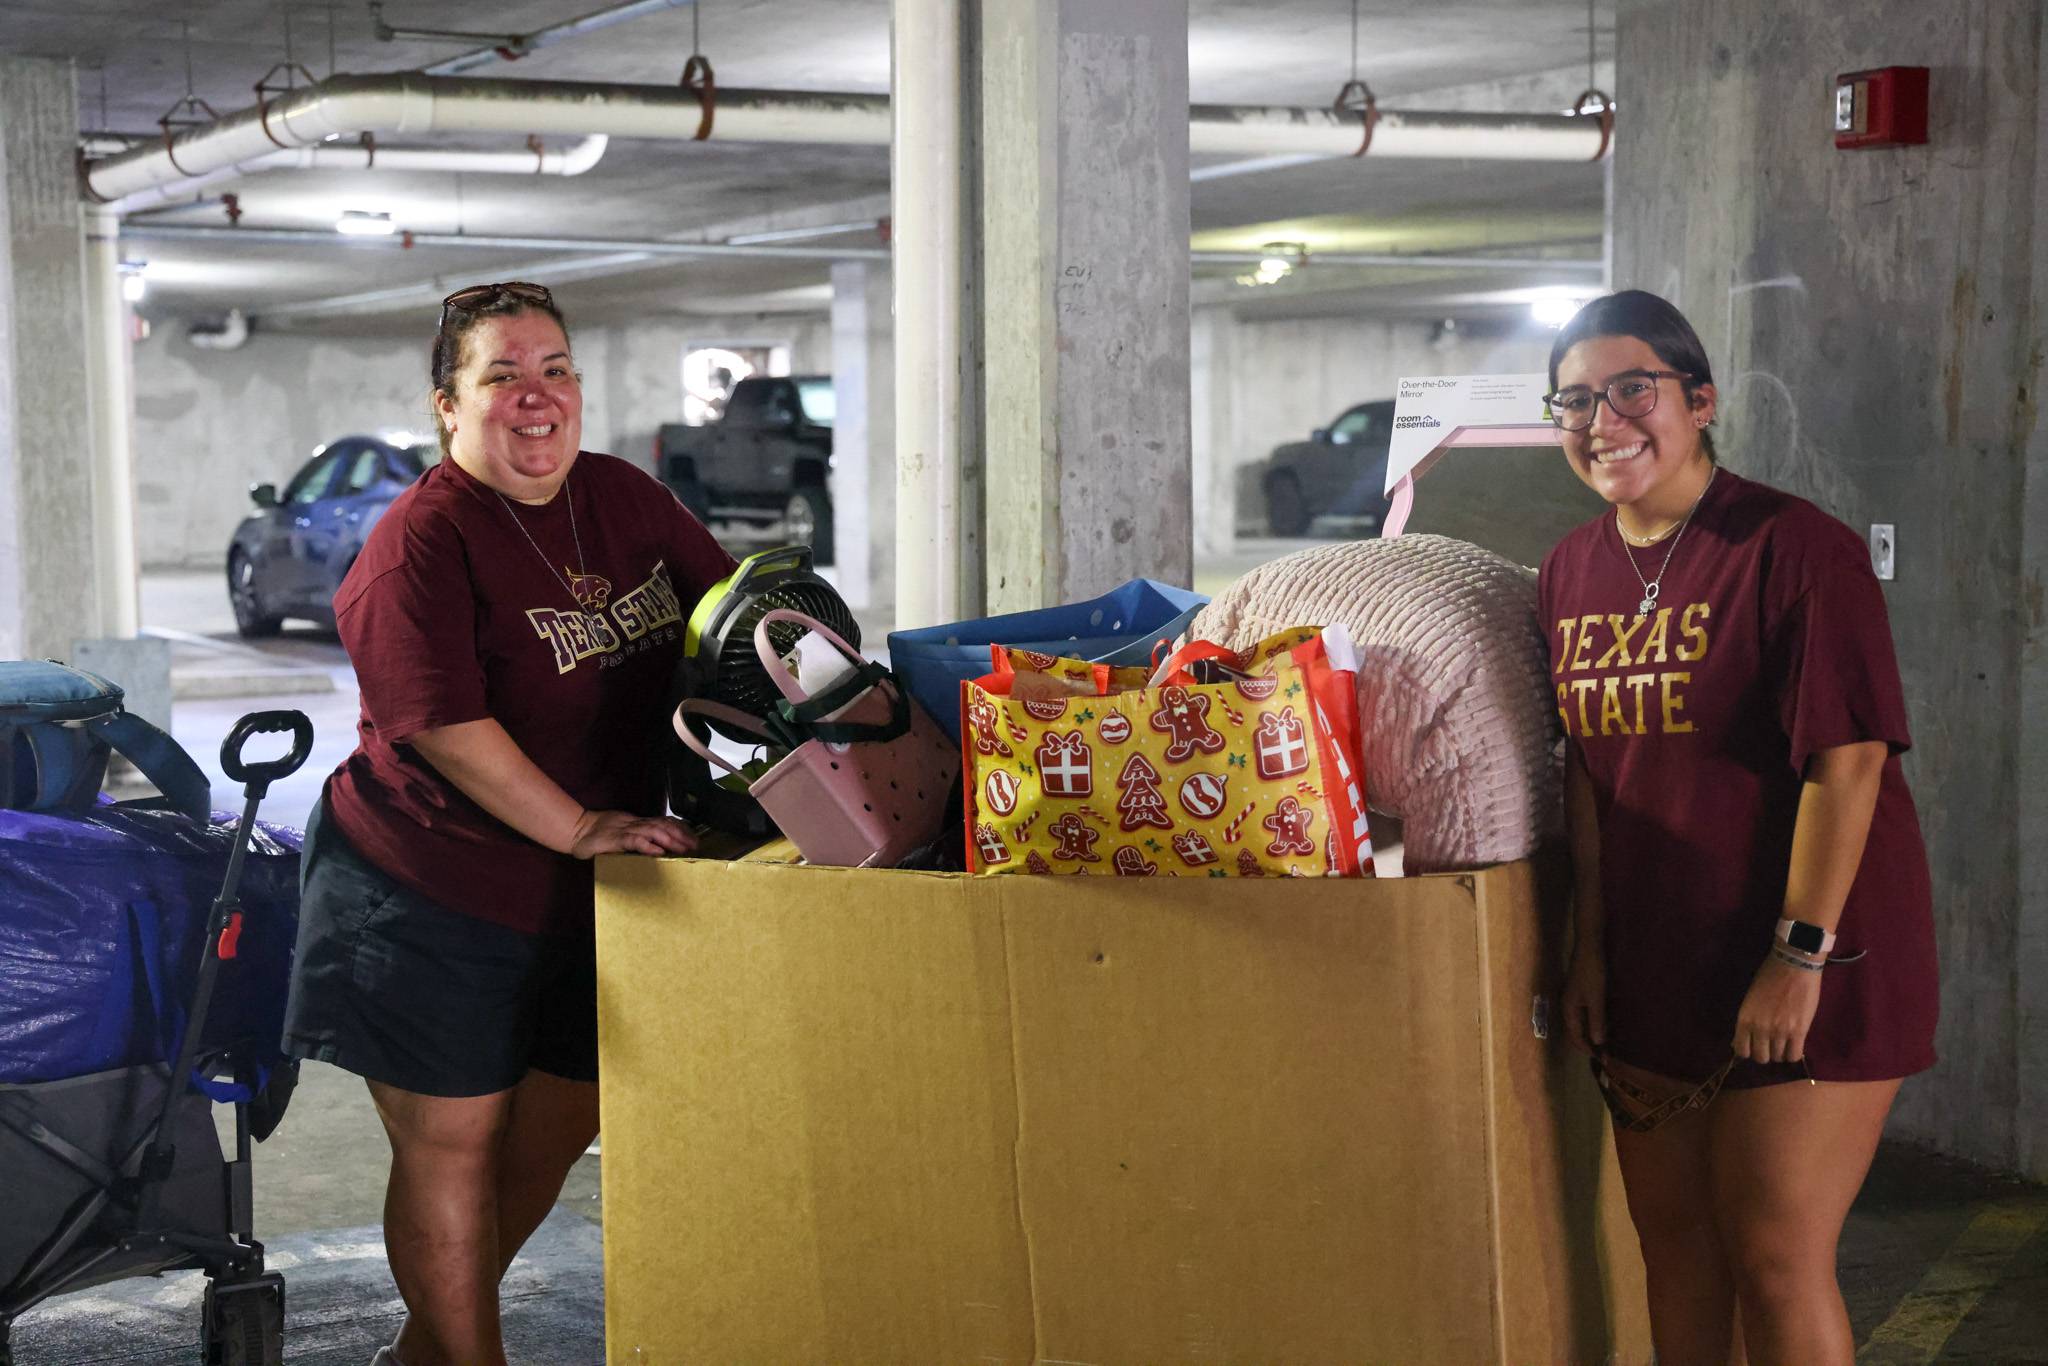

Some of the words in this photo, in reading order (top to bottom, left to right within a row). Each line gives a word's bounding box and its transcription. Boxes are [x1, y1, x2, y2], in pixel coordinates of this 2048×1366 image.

[1401, 380, 1457, 389] Over-the-Door
[1400, 390, 1424, 398] Mirror
[1395, 419, 1441, 429] essentials
[1555, 602, 1711, 674] TEXAS
